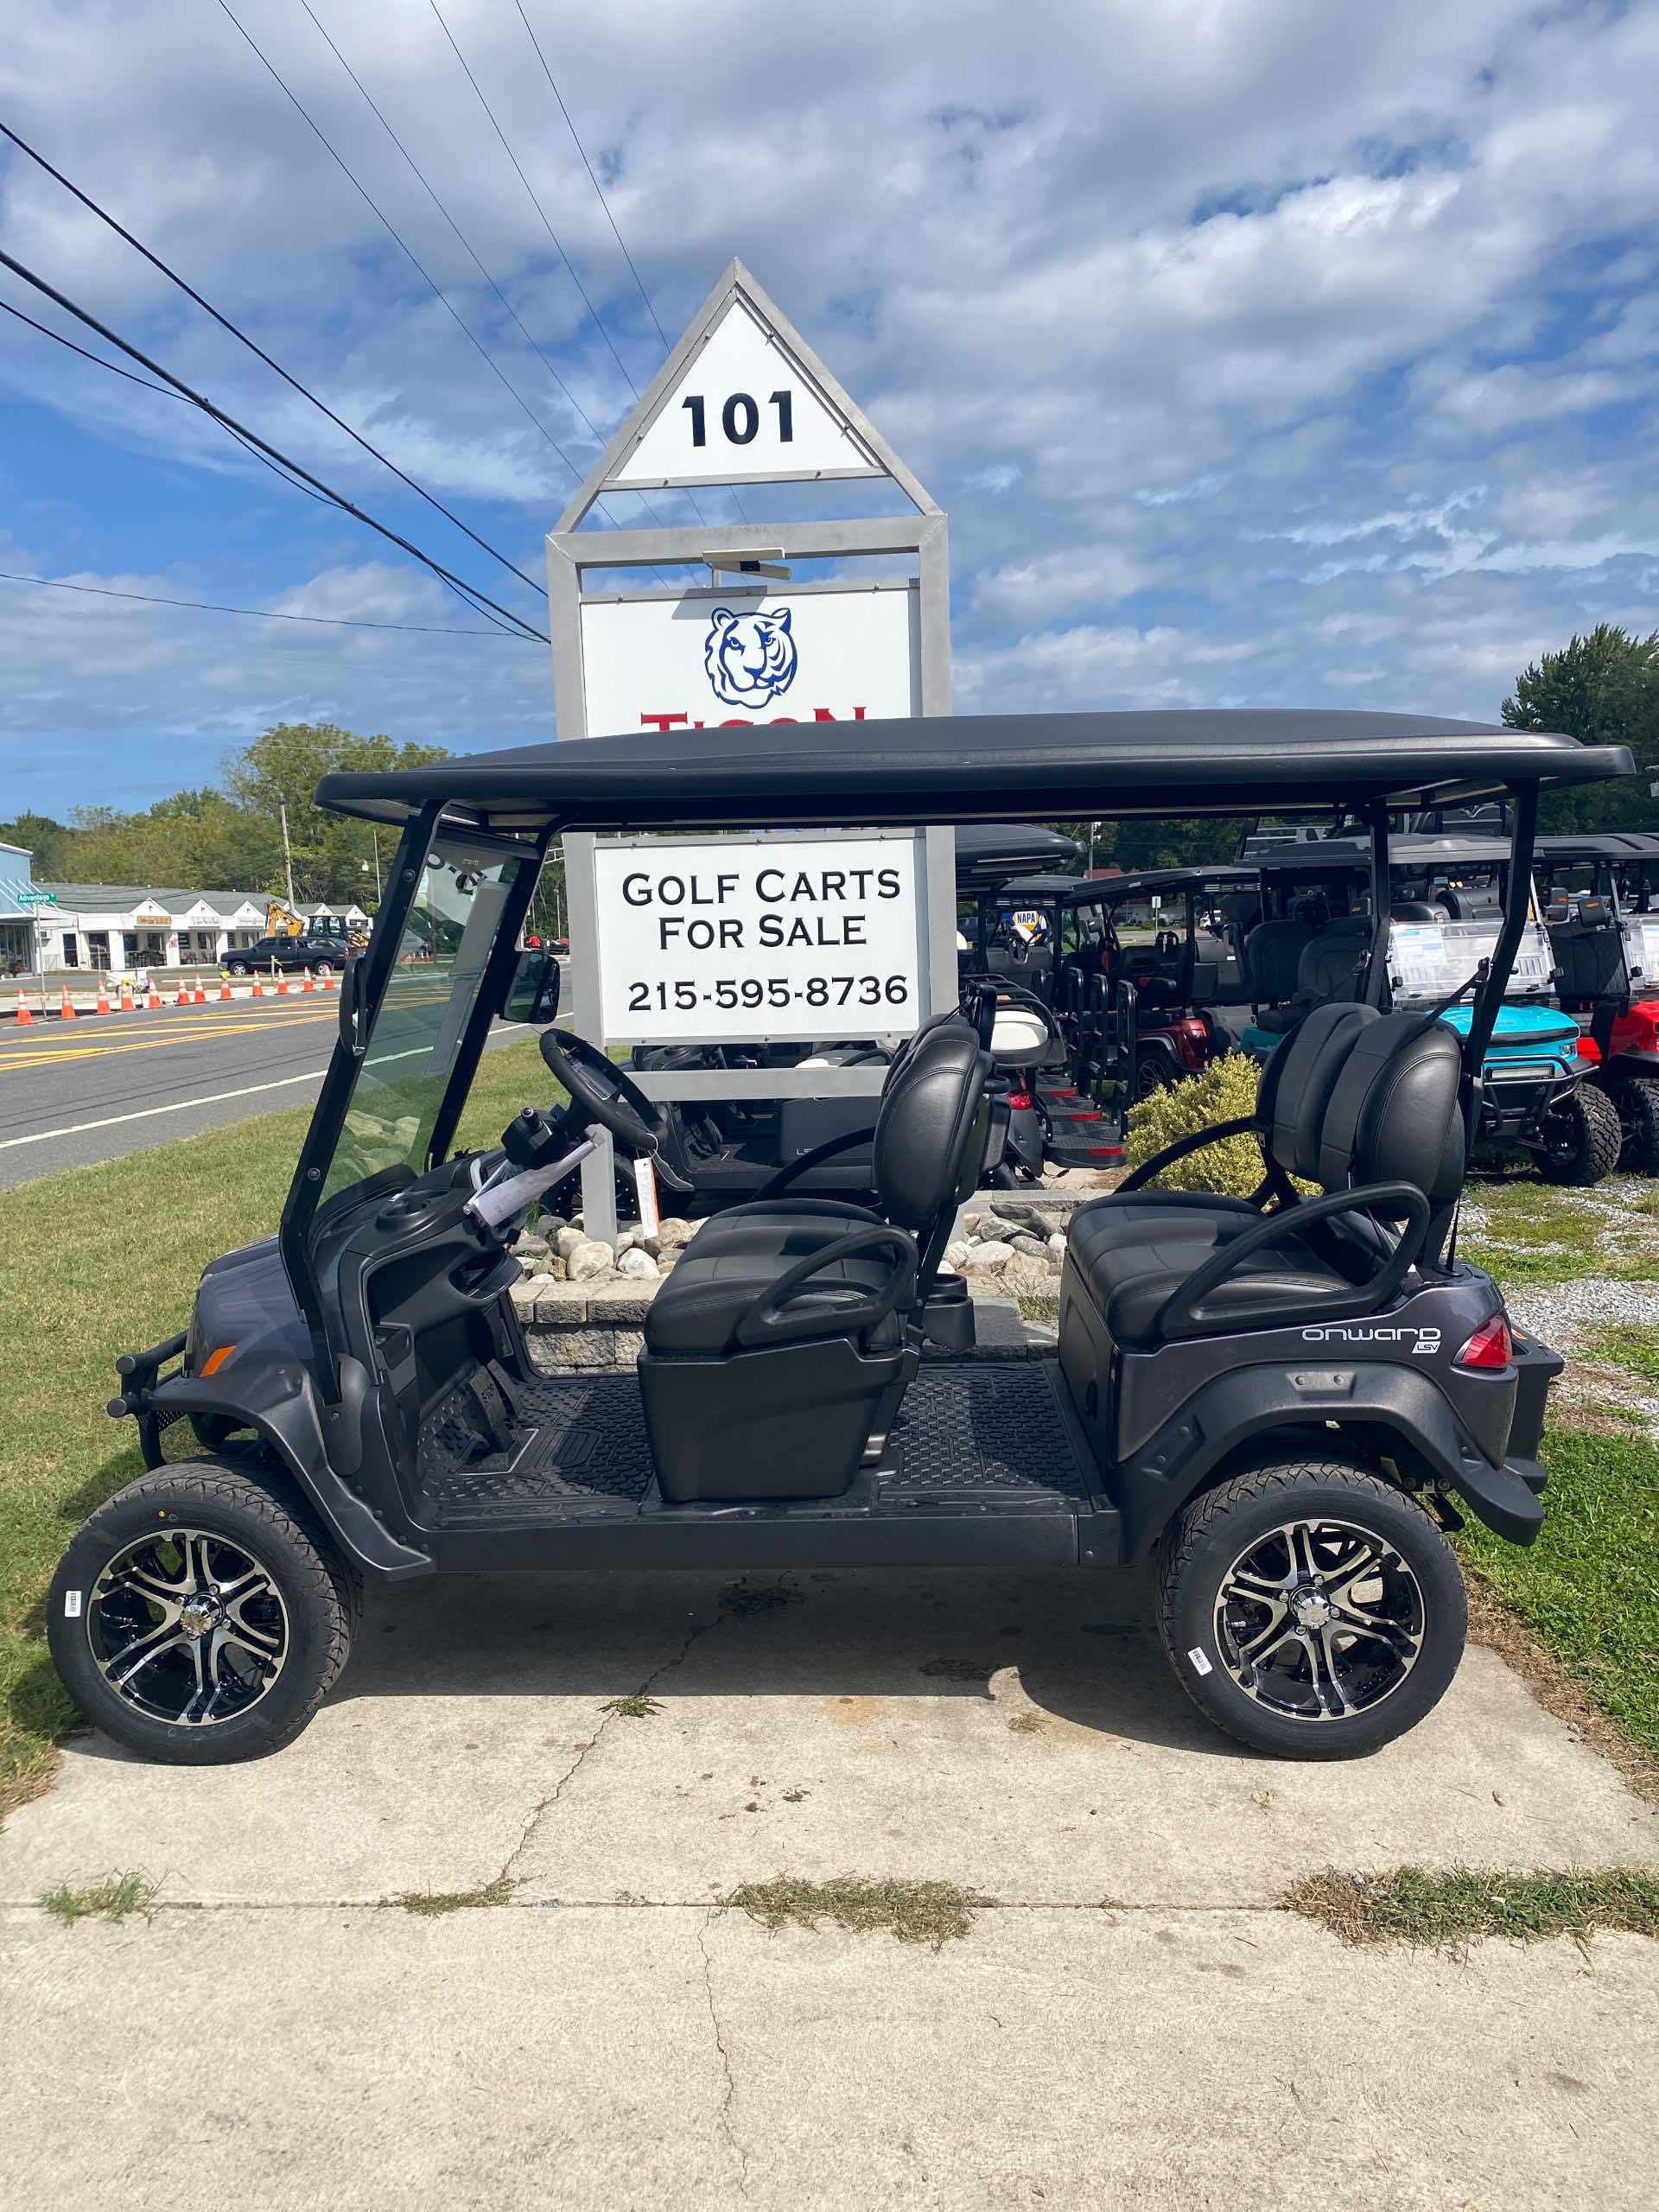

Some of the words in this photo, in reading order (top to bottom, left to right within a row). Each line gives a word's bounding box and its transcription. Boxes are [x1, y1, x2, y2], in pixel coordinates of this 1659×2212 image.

[681, 390, 794, 448] 101
[622, 873, 741, 906] GOLF
[755, 868, 901, 903] CARTS
[658, 916, 745, 950] FOR
[759, 913, 868, 948] SALE
[1017, 912, 1036, 924] NAPA
[627, 975, 909, 1012] 215-595-8736
[1415, 1343, 1440, 1351] LSV
